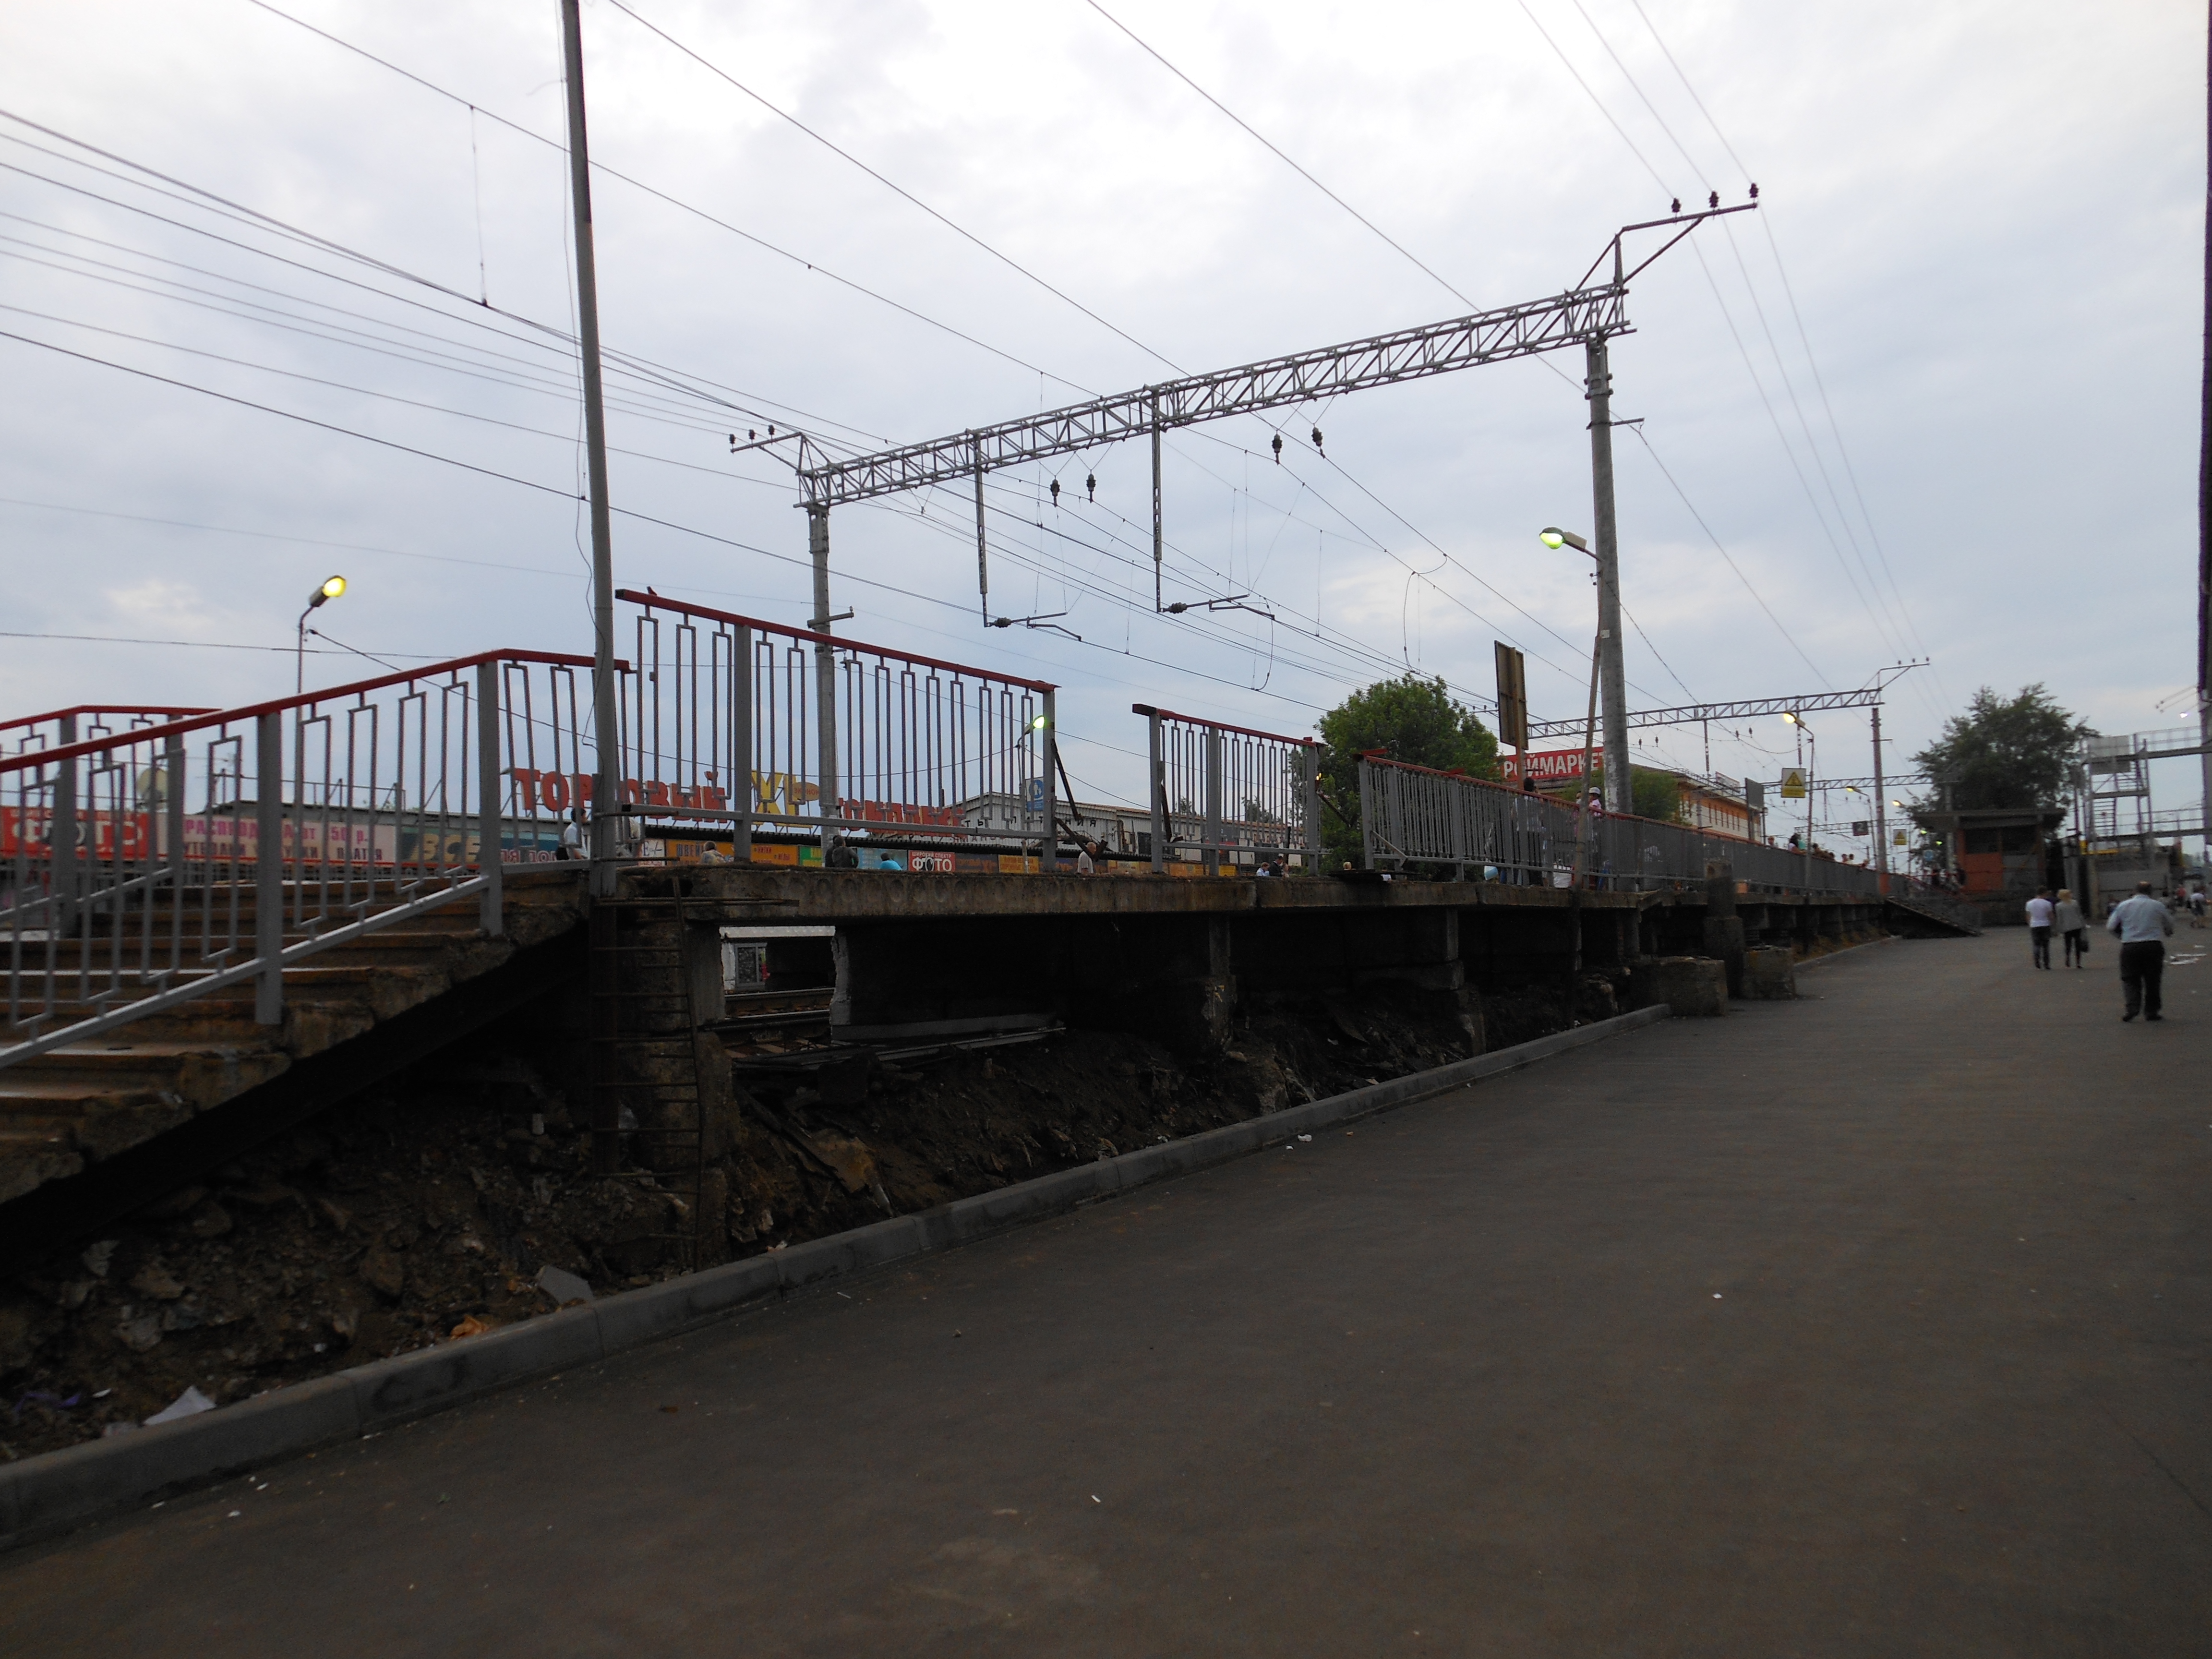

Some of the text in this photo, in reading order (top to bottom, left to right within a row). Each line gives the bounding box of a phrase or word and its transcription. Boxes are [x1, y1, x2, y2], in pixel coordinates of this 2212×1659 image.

[1504, 751, 1604, 779] РЙМАРКЕ
[515, 769, 727, 823] ТОРОВЫЙ
[1857, 822, 1864, 831] 2
[912, 856, 952, 872] ФОТО
